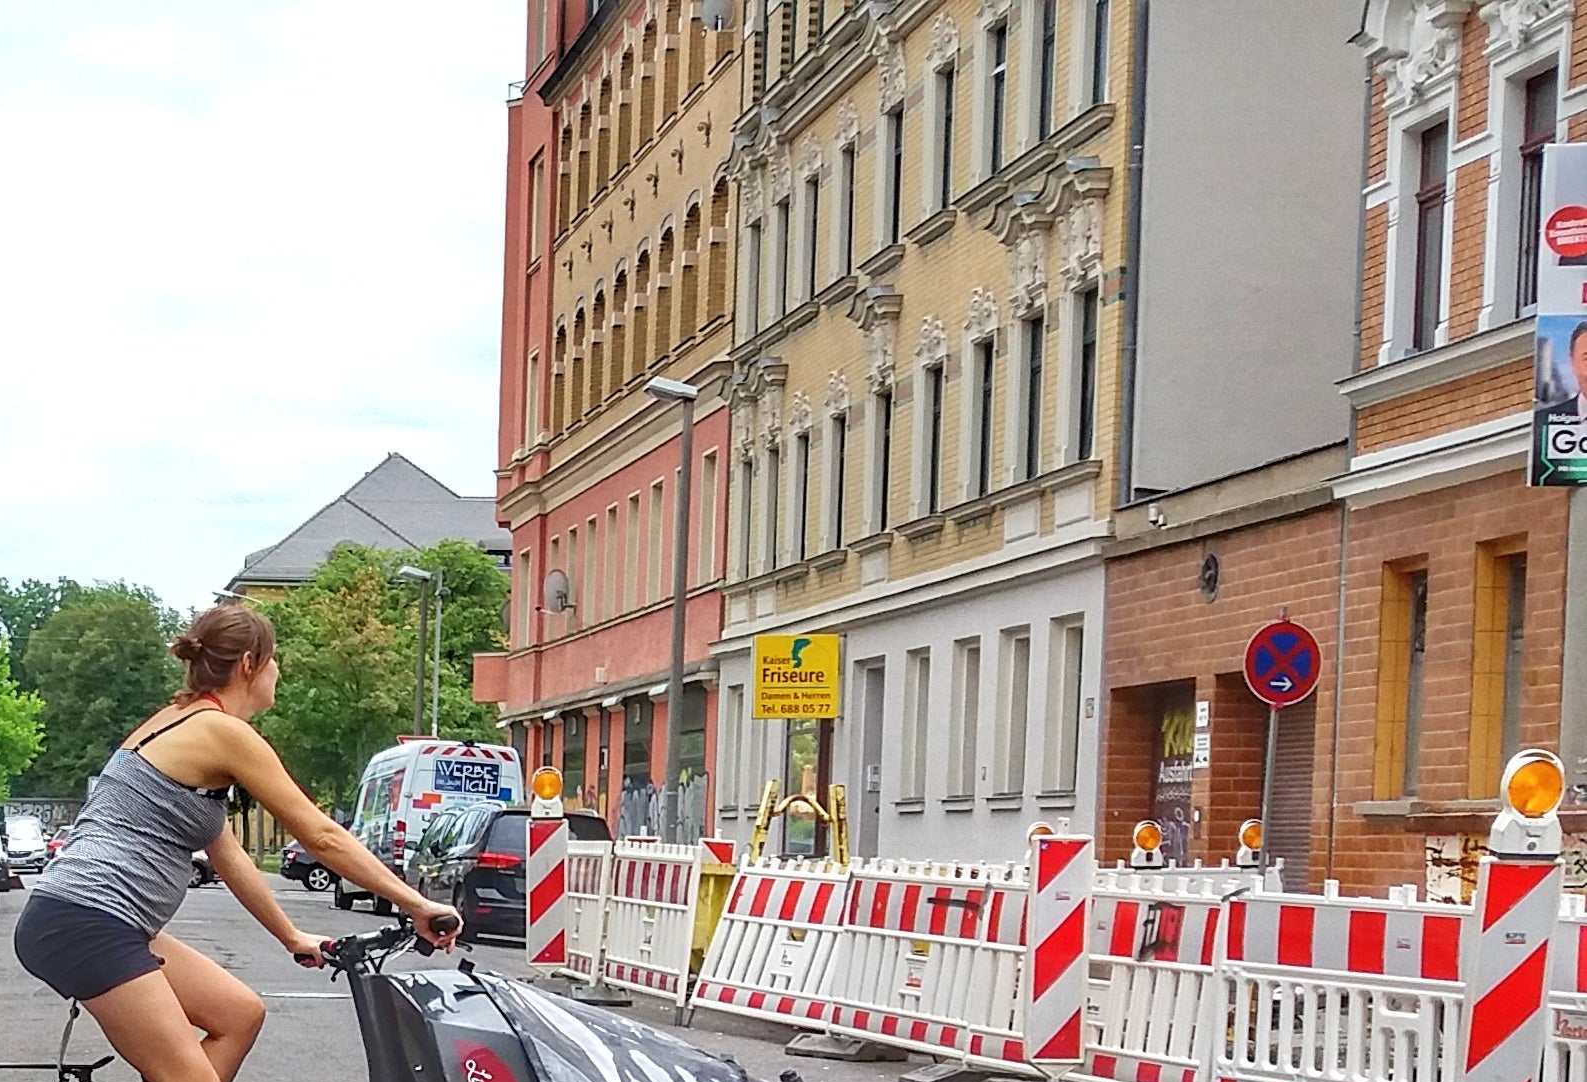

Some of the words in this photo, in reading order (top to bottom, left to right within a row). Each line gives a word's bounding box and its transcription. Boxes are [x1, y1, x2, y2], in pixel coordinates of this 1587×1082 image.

[762, 655, 791, 665] Kaiser
[762, 666, 825, 683] Friseure
[761, 692, 792, 700] Damen
[793, 692, 800, 700] &
[802, 692, 831, 700] Herren
[761, 704, 779, 713] Tel.
[780, 704, 800, 714] 688
[802, 704, 816, 713] 05
[818, 704, 831, 713] 77
